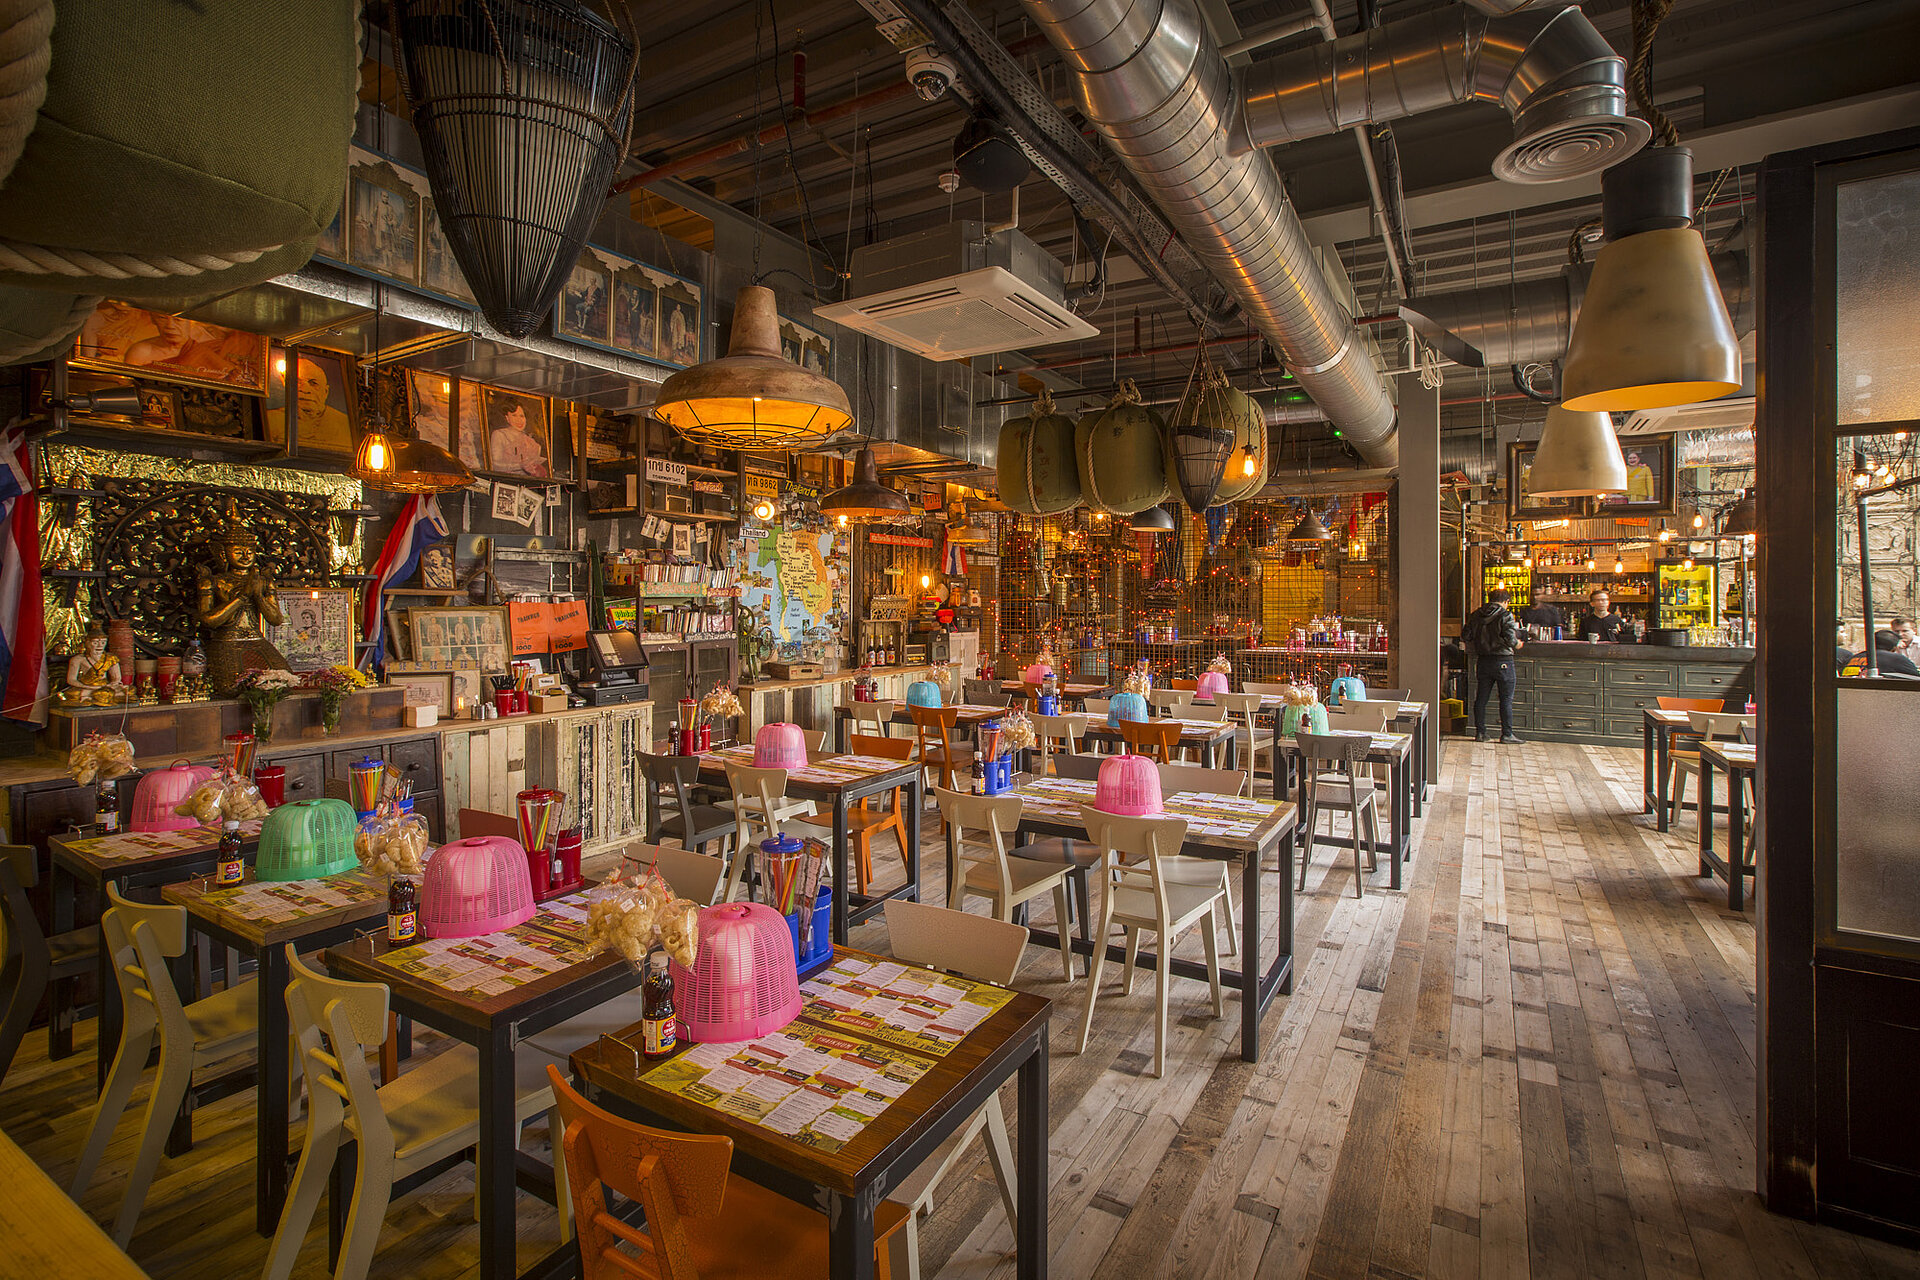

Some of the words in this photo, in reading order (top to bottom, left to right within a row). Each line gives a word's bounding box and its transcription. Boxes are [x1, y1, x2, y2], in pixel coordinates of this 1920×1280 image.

[665, 463, 685, 475] 6102
[759, 478, 777, 490] 9862
[741, 528, 766, 537] Thailand
[555, 642, 574, 650] FOOD
